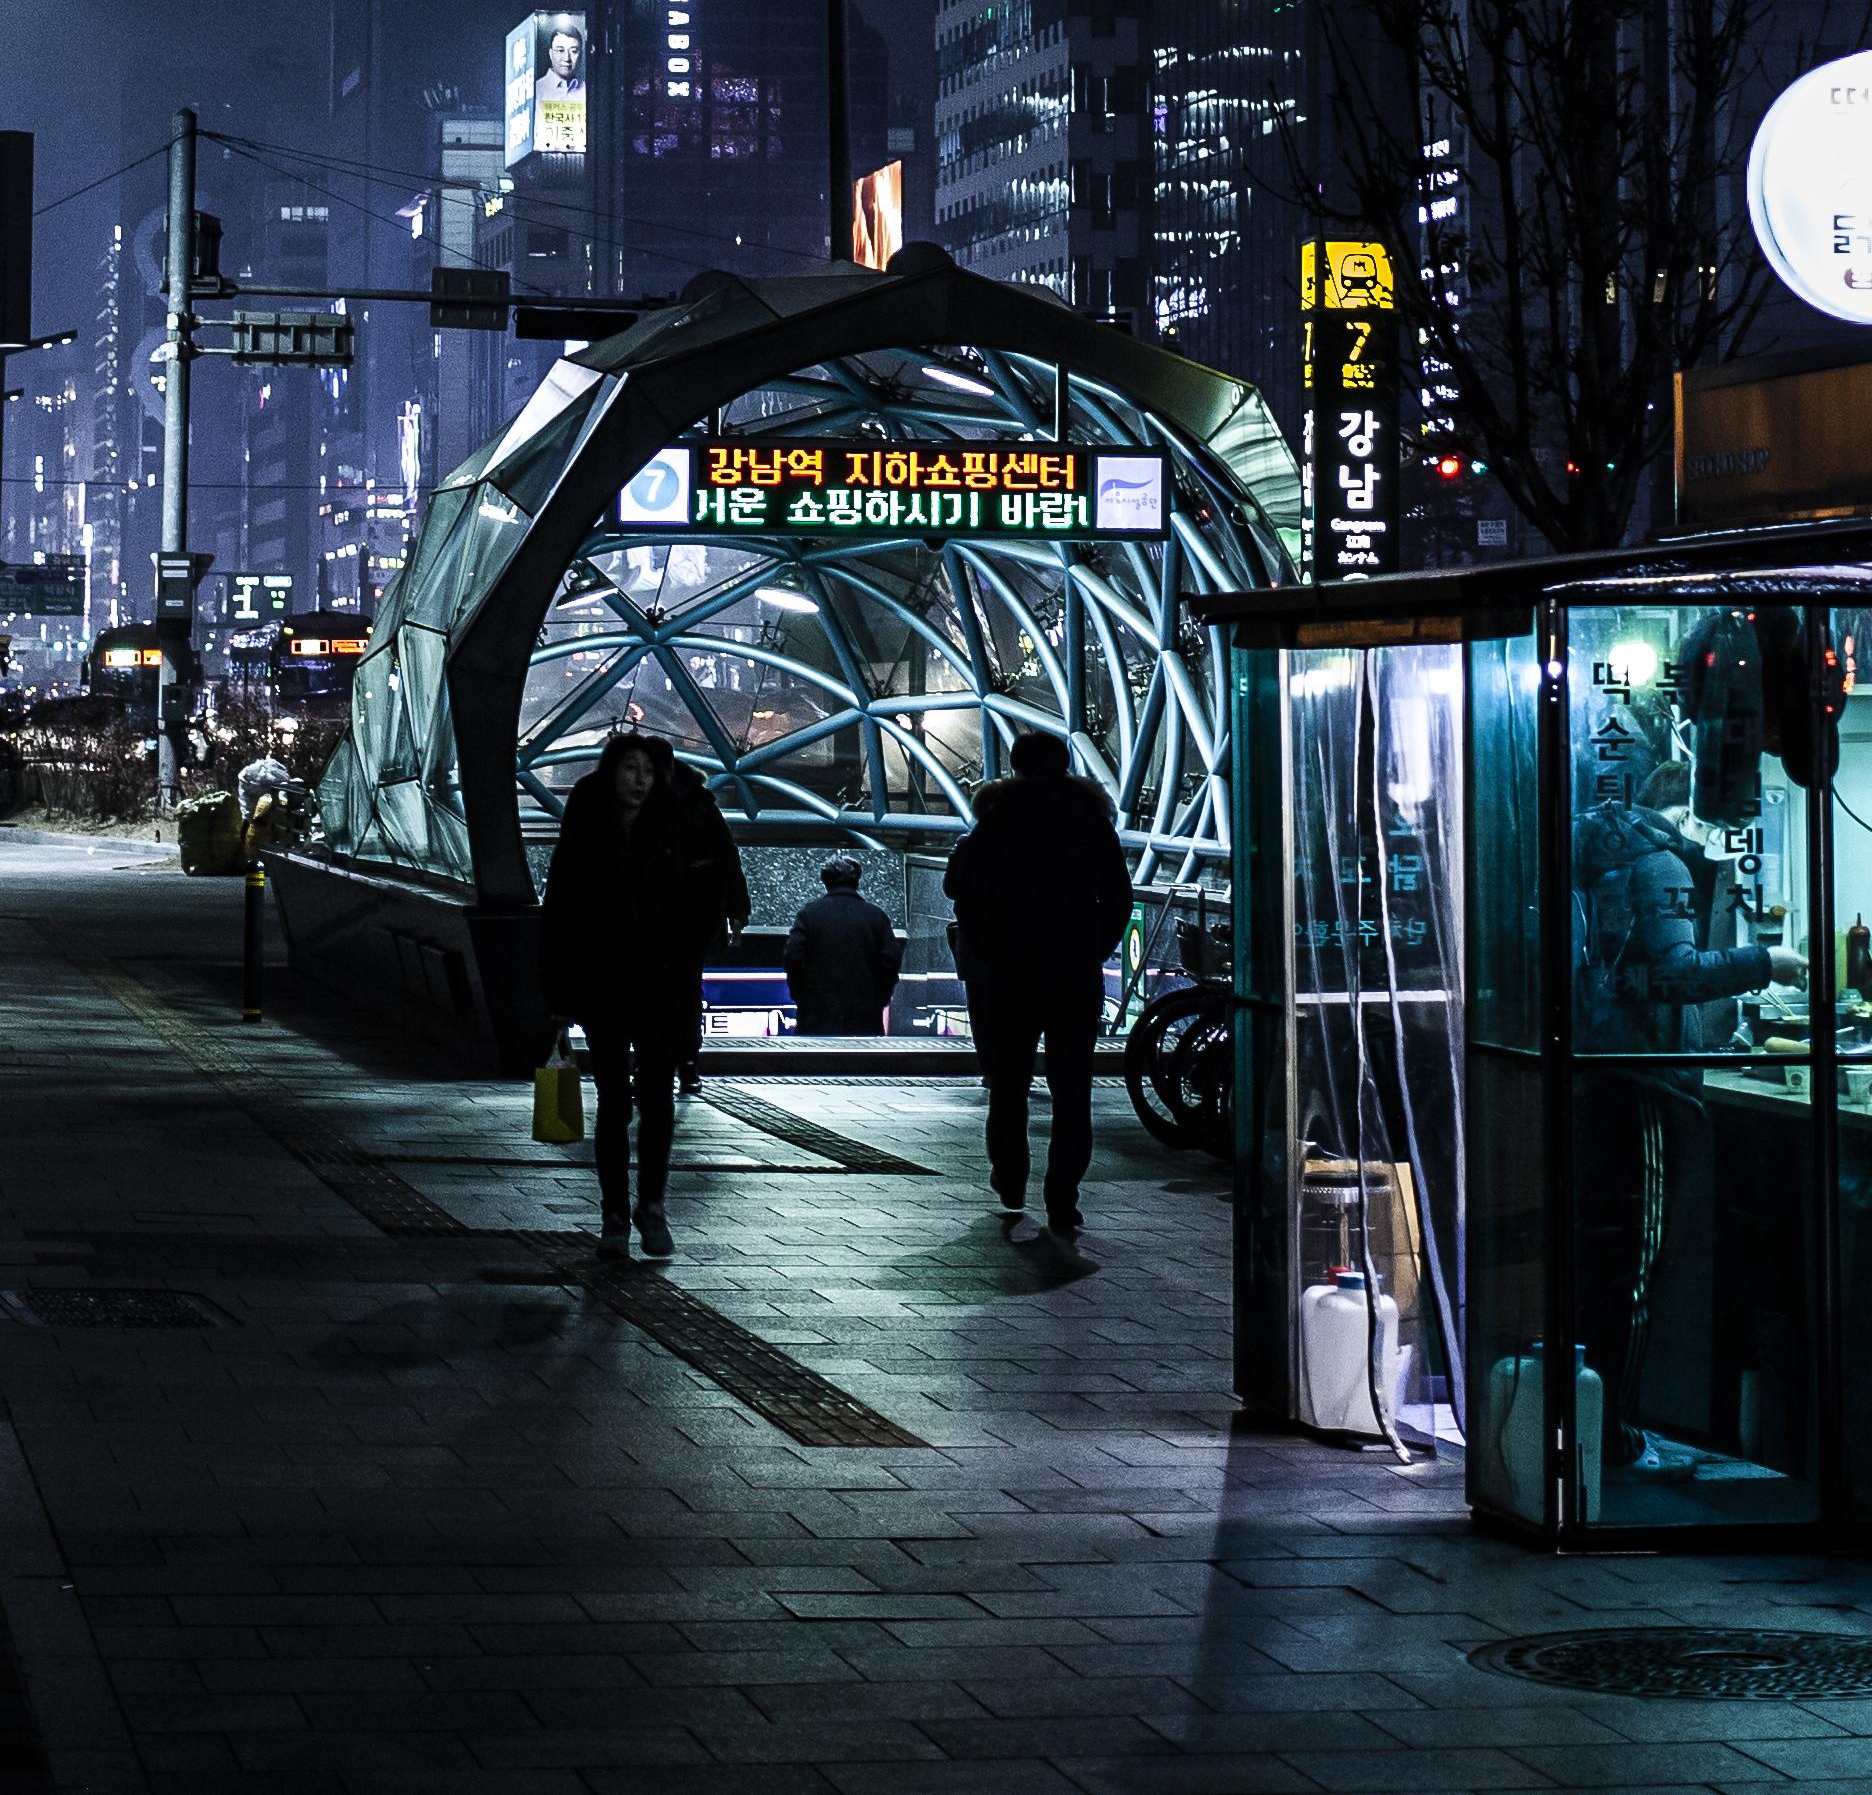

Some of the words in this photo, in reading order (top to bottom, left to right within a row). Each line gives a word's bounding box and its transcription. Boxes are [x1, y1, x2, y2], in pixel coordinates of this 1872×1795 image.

[1346, 322, 1371, 361] 7
[707, 448, 825, 486] 강남역
[845, 452, 1076, 489] 지하쇼핑센터
[1334, 409, 1380, 510] 강남
[644, 468, 661, 503] 7
[786, 489, 979, 527] 쇼핑하시기
[1330, 517, 1387, 534] Gangnam
